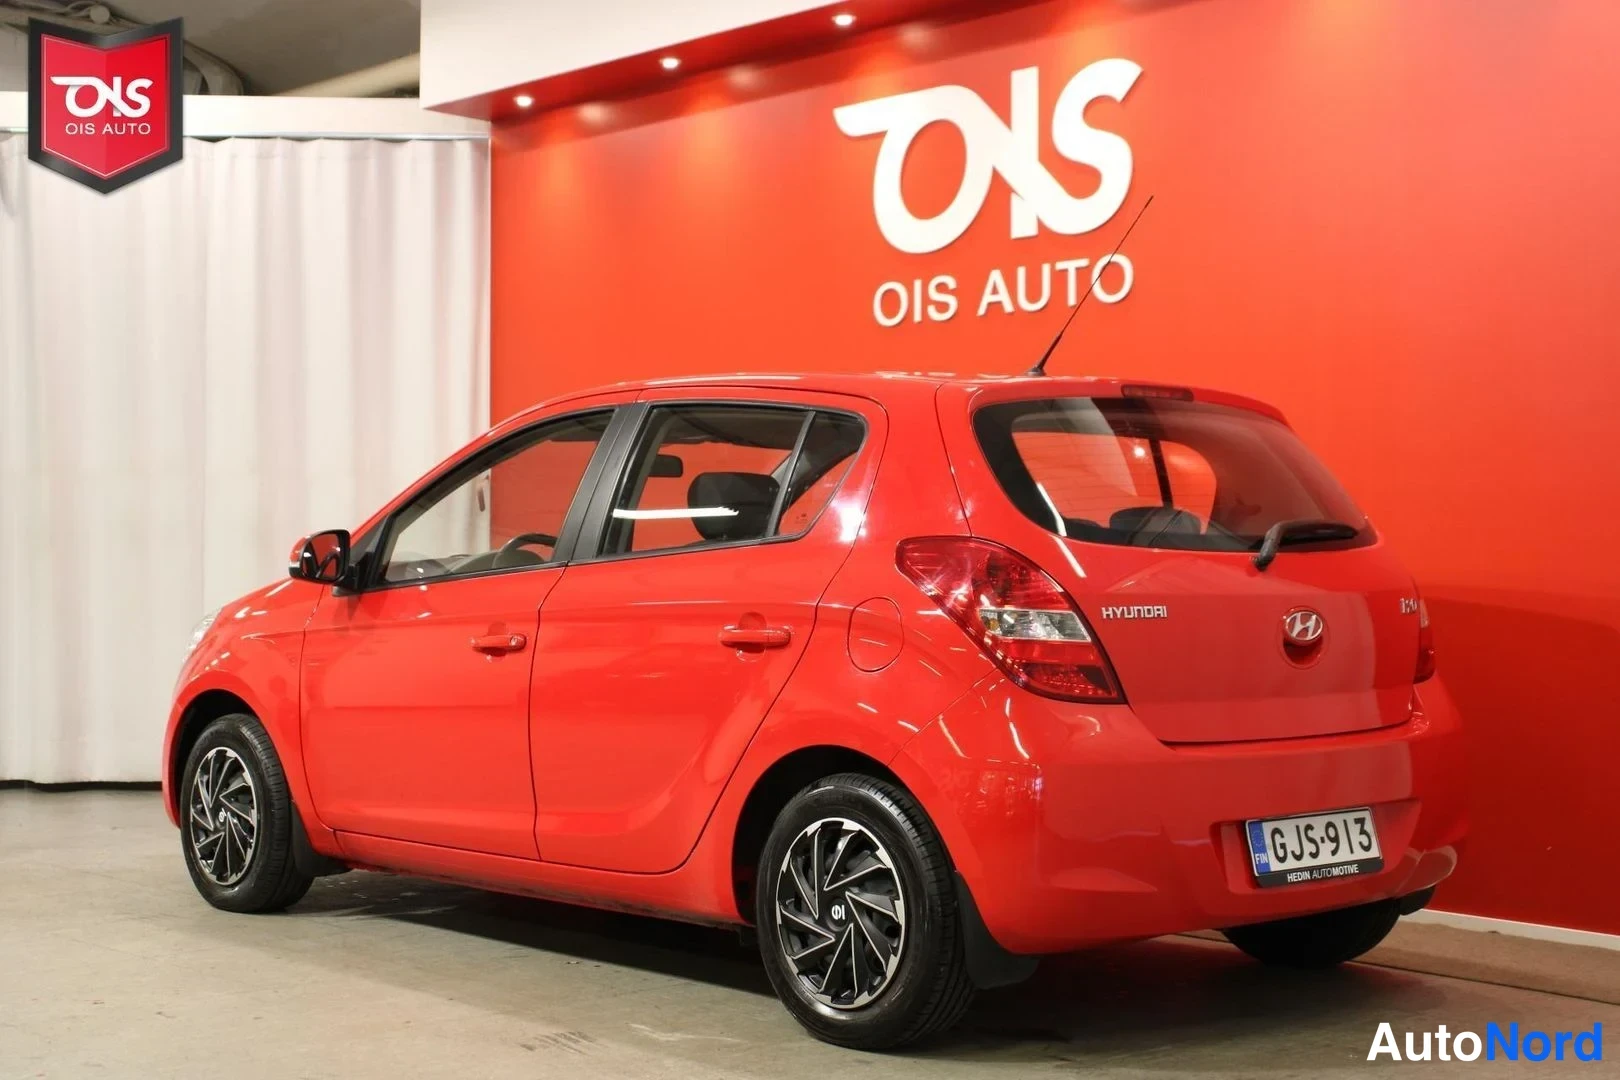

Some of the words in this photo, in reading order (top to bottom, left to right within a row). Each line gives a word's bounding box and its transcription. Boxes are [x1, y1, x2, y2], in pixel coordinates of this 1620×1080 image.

[832, 57, 1144, 254] OIS
[872, 274, 959, 327] OIS
[976, 252, 1135, 317] AUTO
[1101, 605, 1168, 619] HYUNDAI
[1255, 853, 1269, 865] FIN
[1287, 871, 1311, 883] HEDIN
[1312, 863, 1360, 879] AUTOMOTIVE
